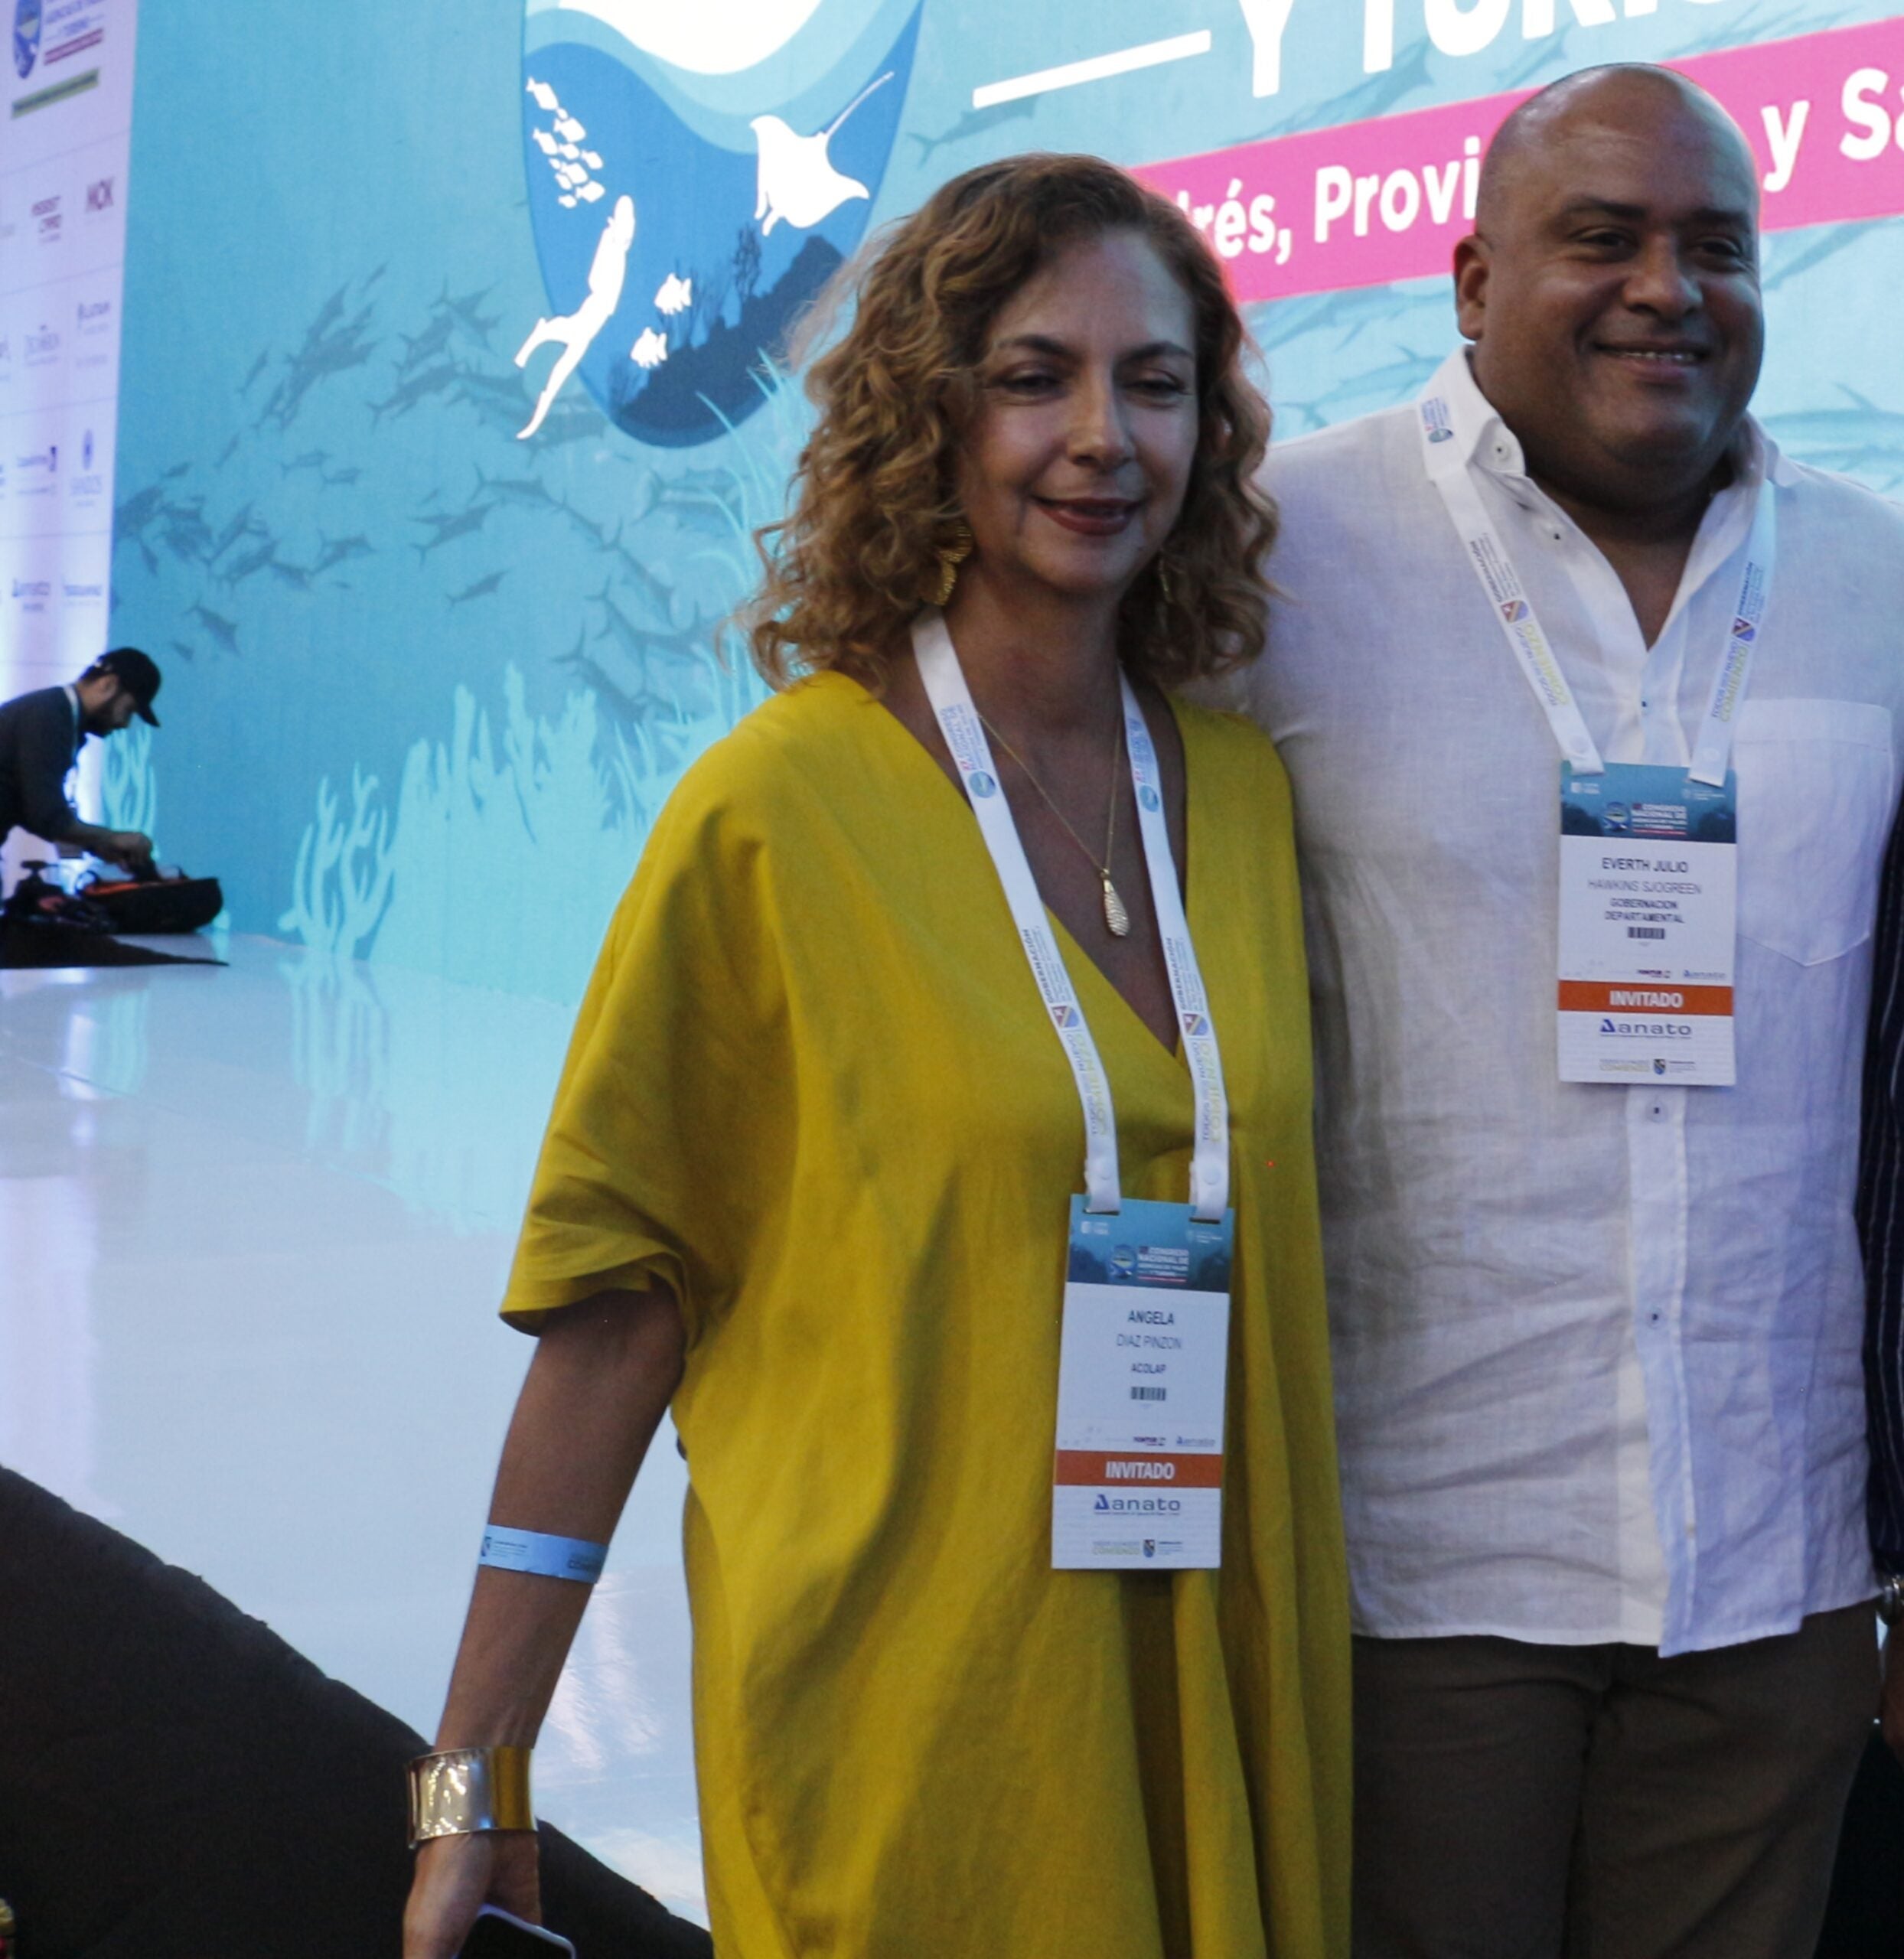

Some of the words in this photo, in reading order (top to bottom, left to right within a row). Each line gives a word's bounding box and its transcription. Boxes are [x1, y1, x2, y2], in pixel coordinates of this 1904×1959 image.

[1177, 178, 1291, 265] rés,
[1761, 99, 1810, 193] y
[1609, 990, 1684, 1009] INVITADO
[1618, 1022, 1693, 1036] anato
[1127, 1310, 1175, 1325] ANGELA
[1105, 1461, 1175, 1480] INVITADO
[1112, 1498, 1181, 1511] anato
